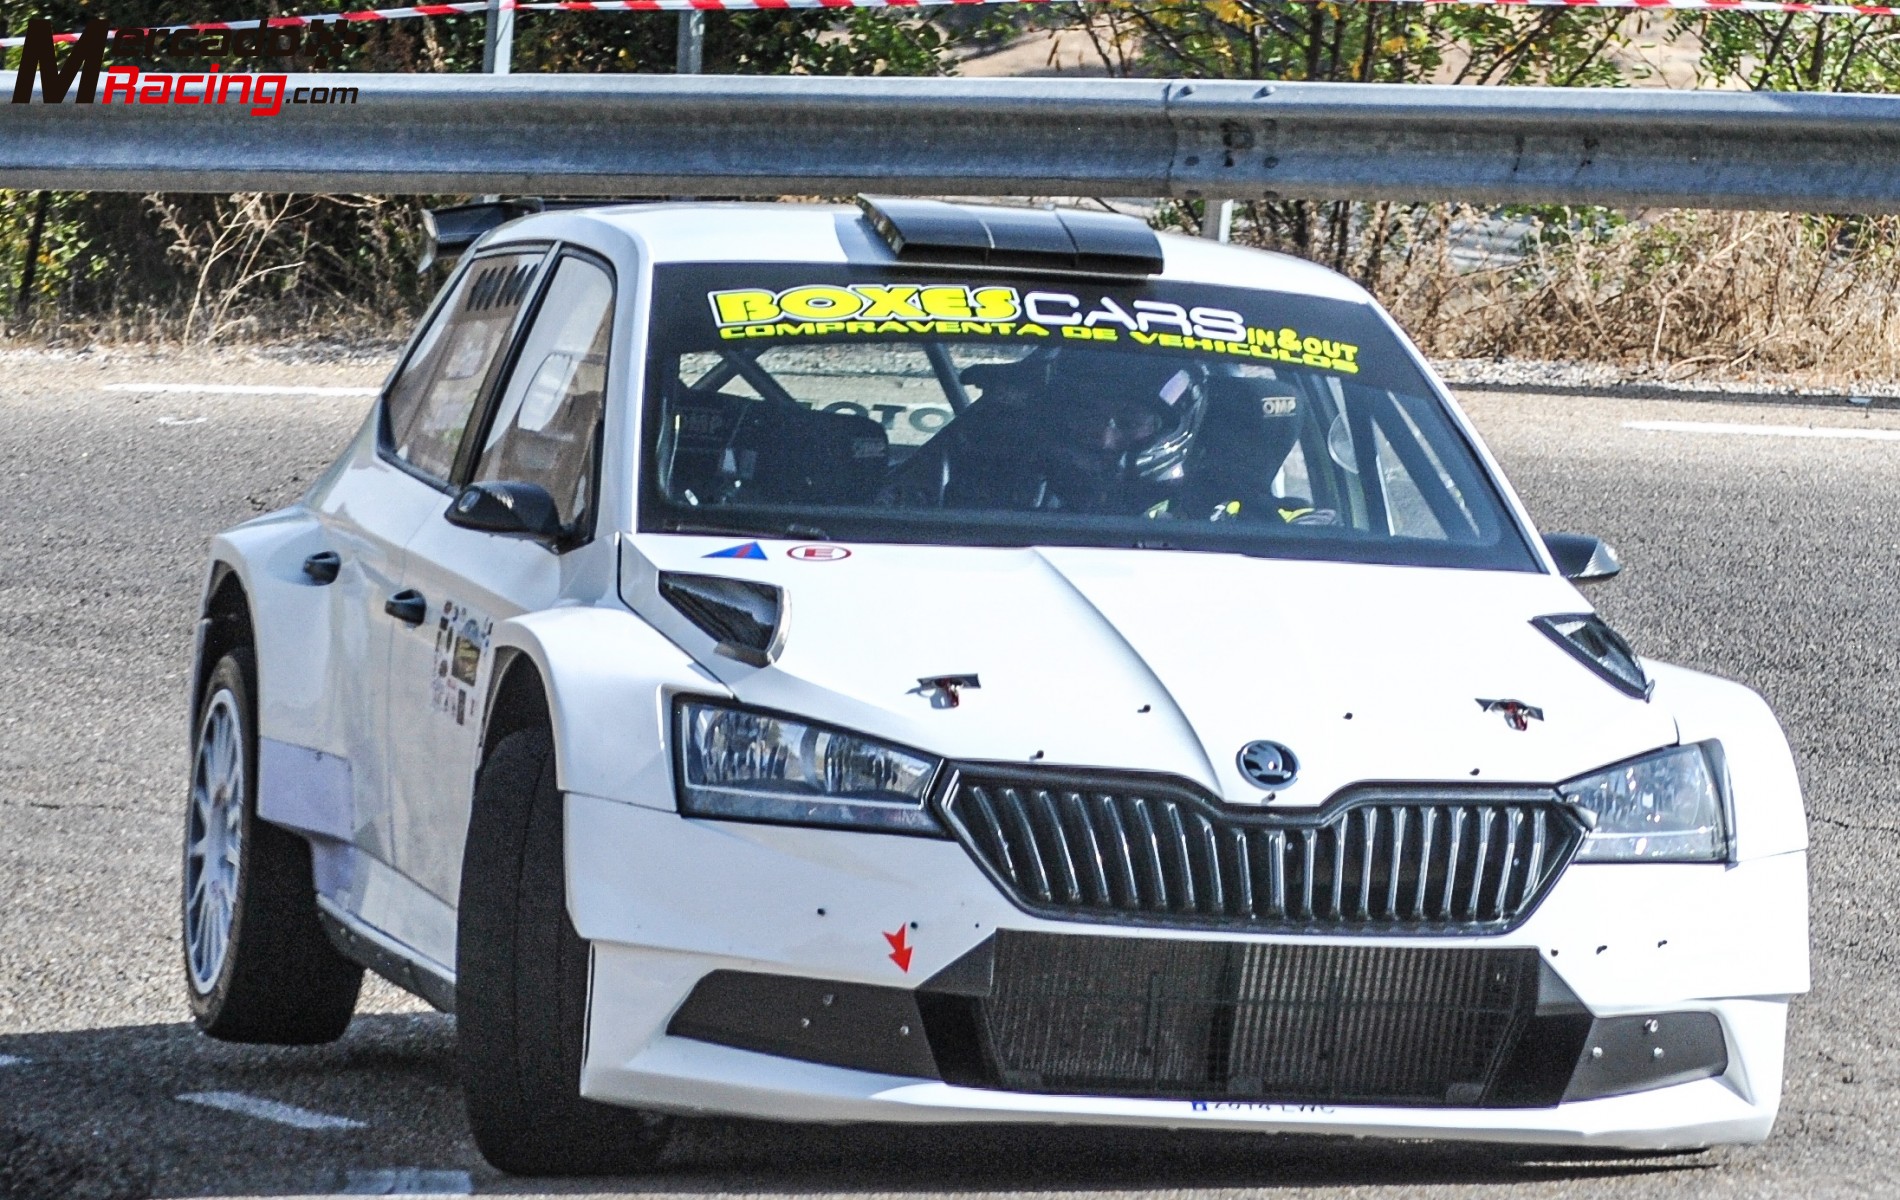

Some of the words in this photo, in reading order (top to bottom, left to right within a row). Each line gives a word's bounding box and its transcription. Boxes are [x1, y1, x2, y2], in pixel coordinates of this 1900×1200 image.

[708, 284, 1021, 327] BOXES
[719, 321, 1050, 339] COMPRAVENTA
[1062, 326, 1118, 341] DE
[1129, 331, 1359, 374] VEHICULOS
[1262, 397, 1297, 417] OMP
